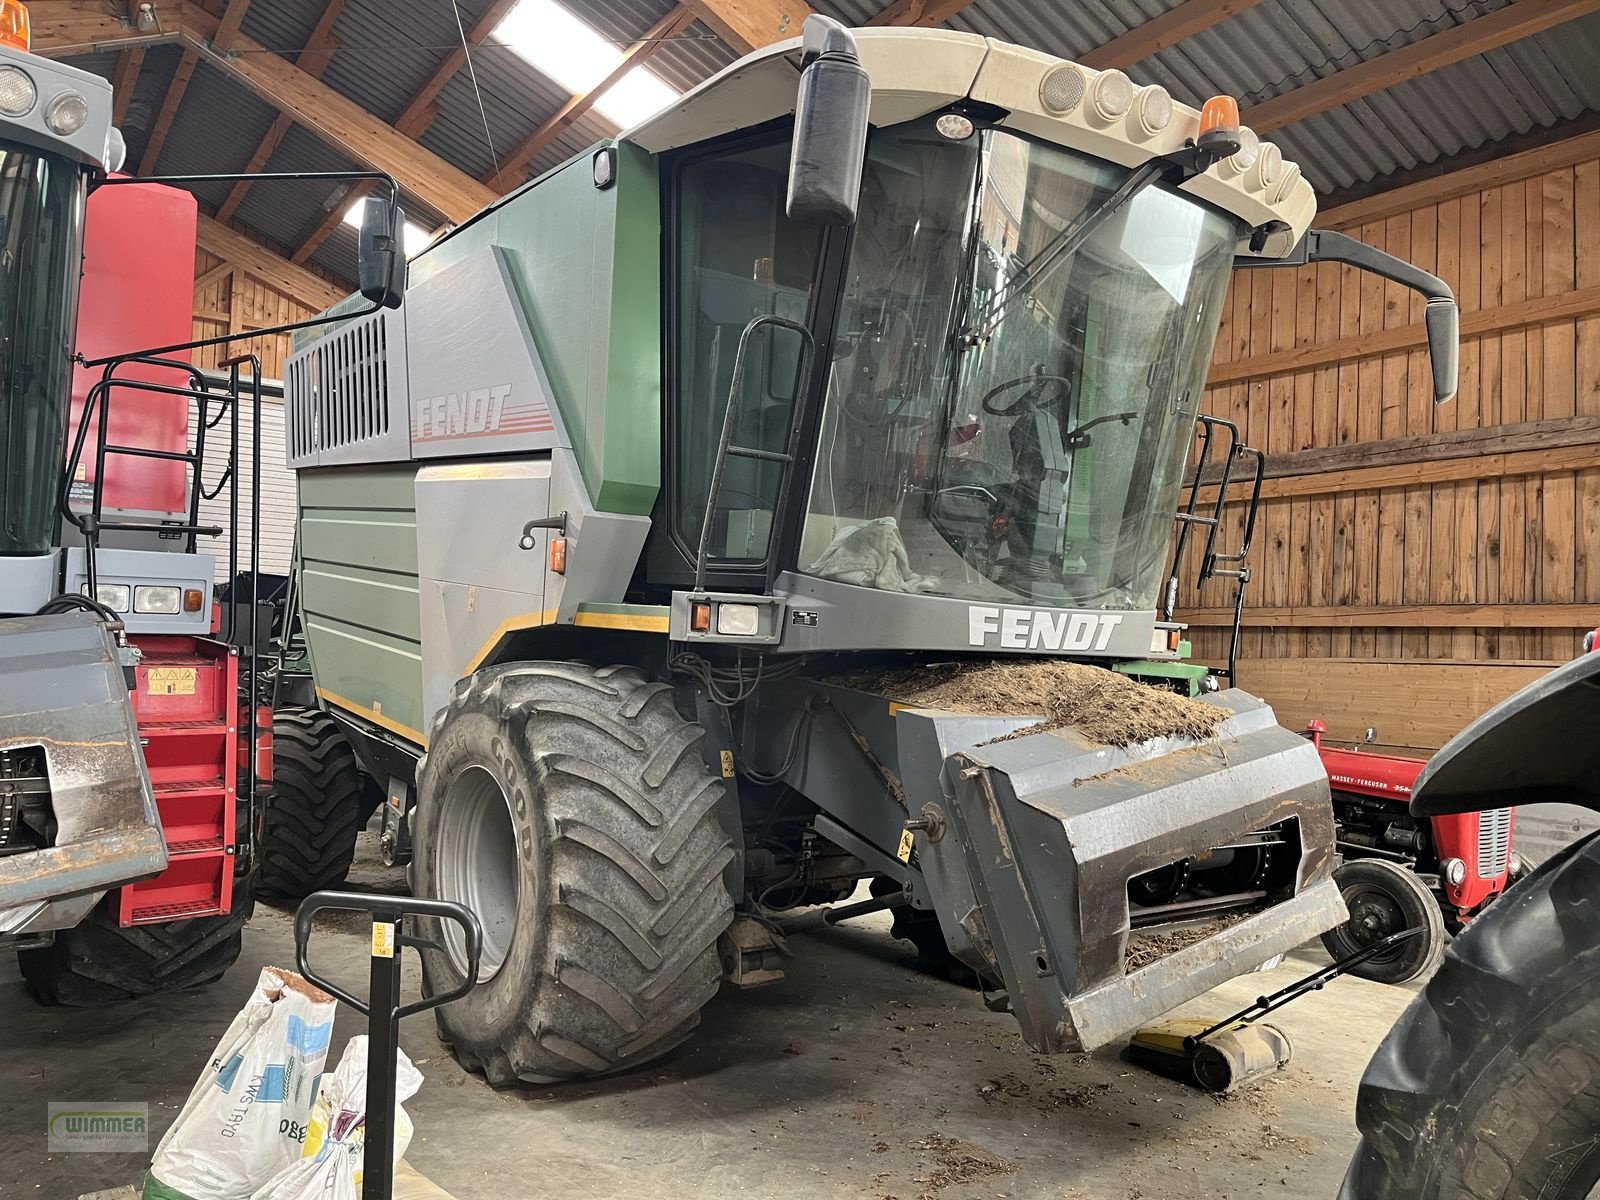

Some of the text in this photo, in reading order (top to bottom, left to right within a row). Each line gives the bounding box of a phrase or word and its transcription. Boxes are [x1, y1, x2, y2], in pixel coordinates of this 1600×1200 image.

[415, 383, 512, 438] FENDT
[968, 605, 1124, 651] FENDT
[221, 1074, 265, 1138] KWS TAYO
